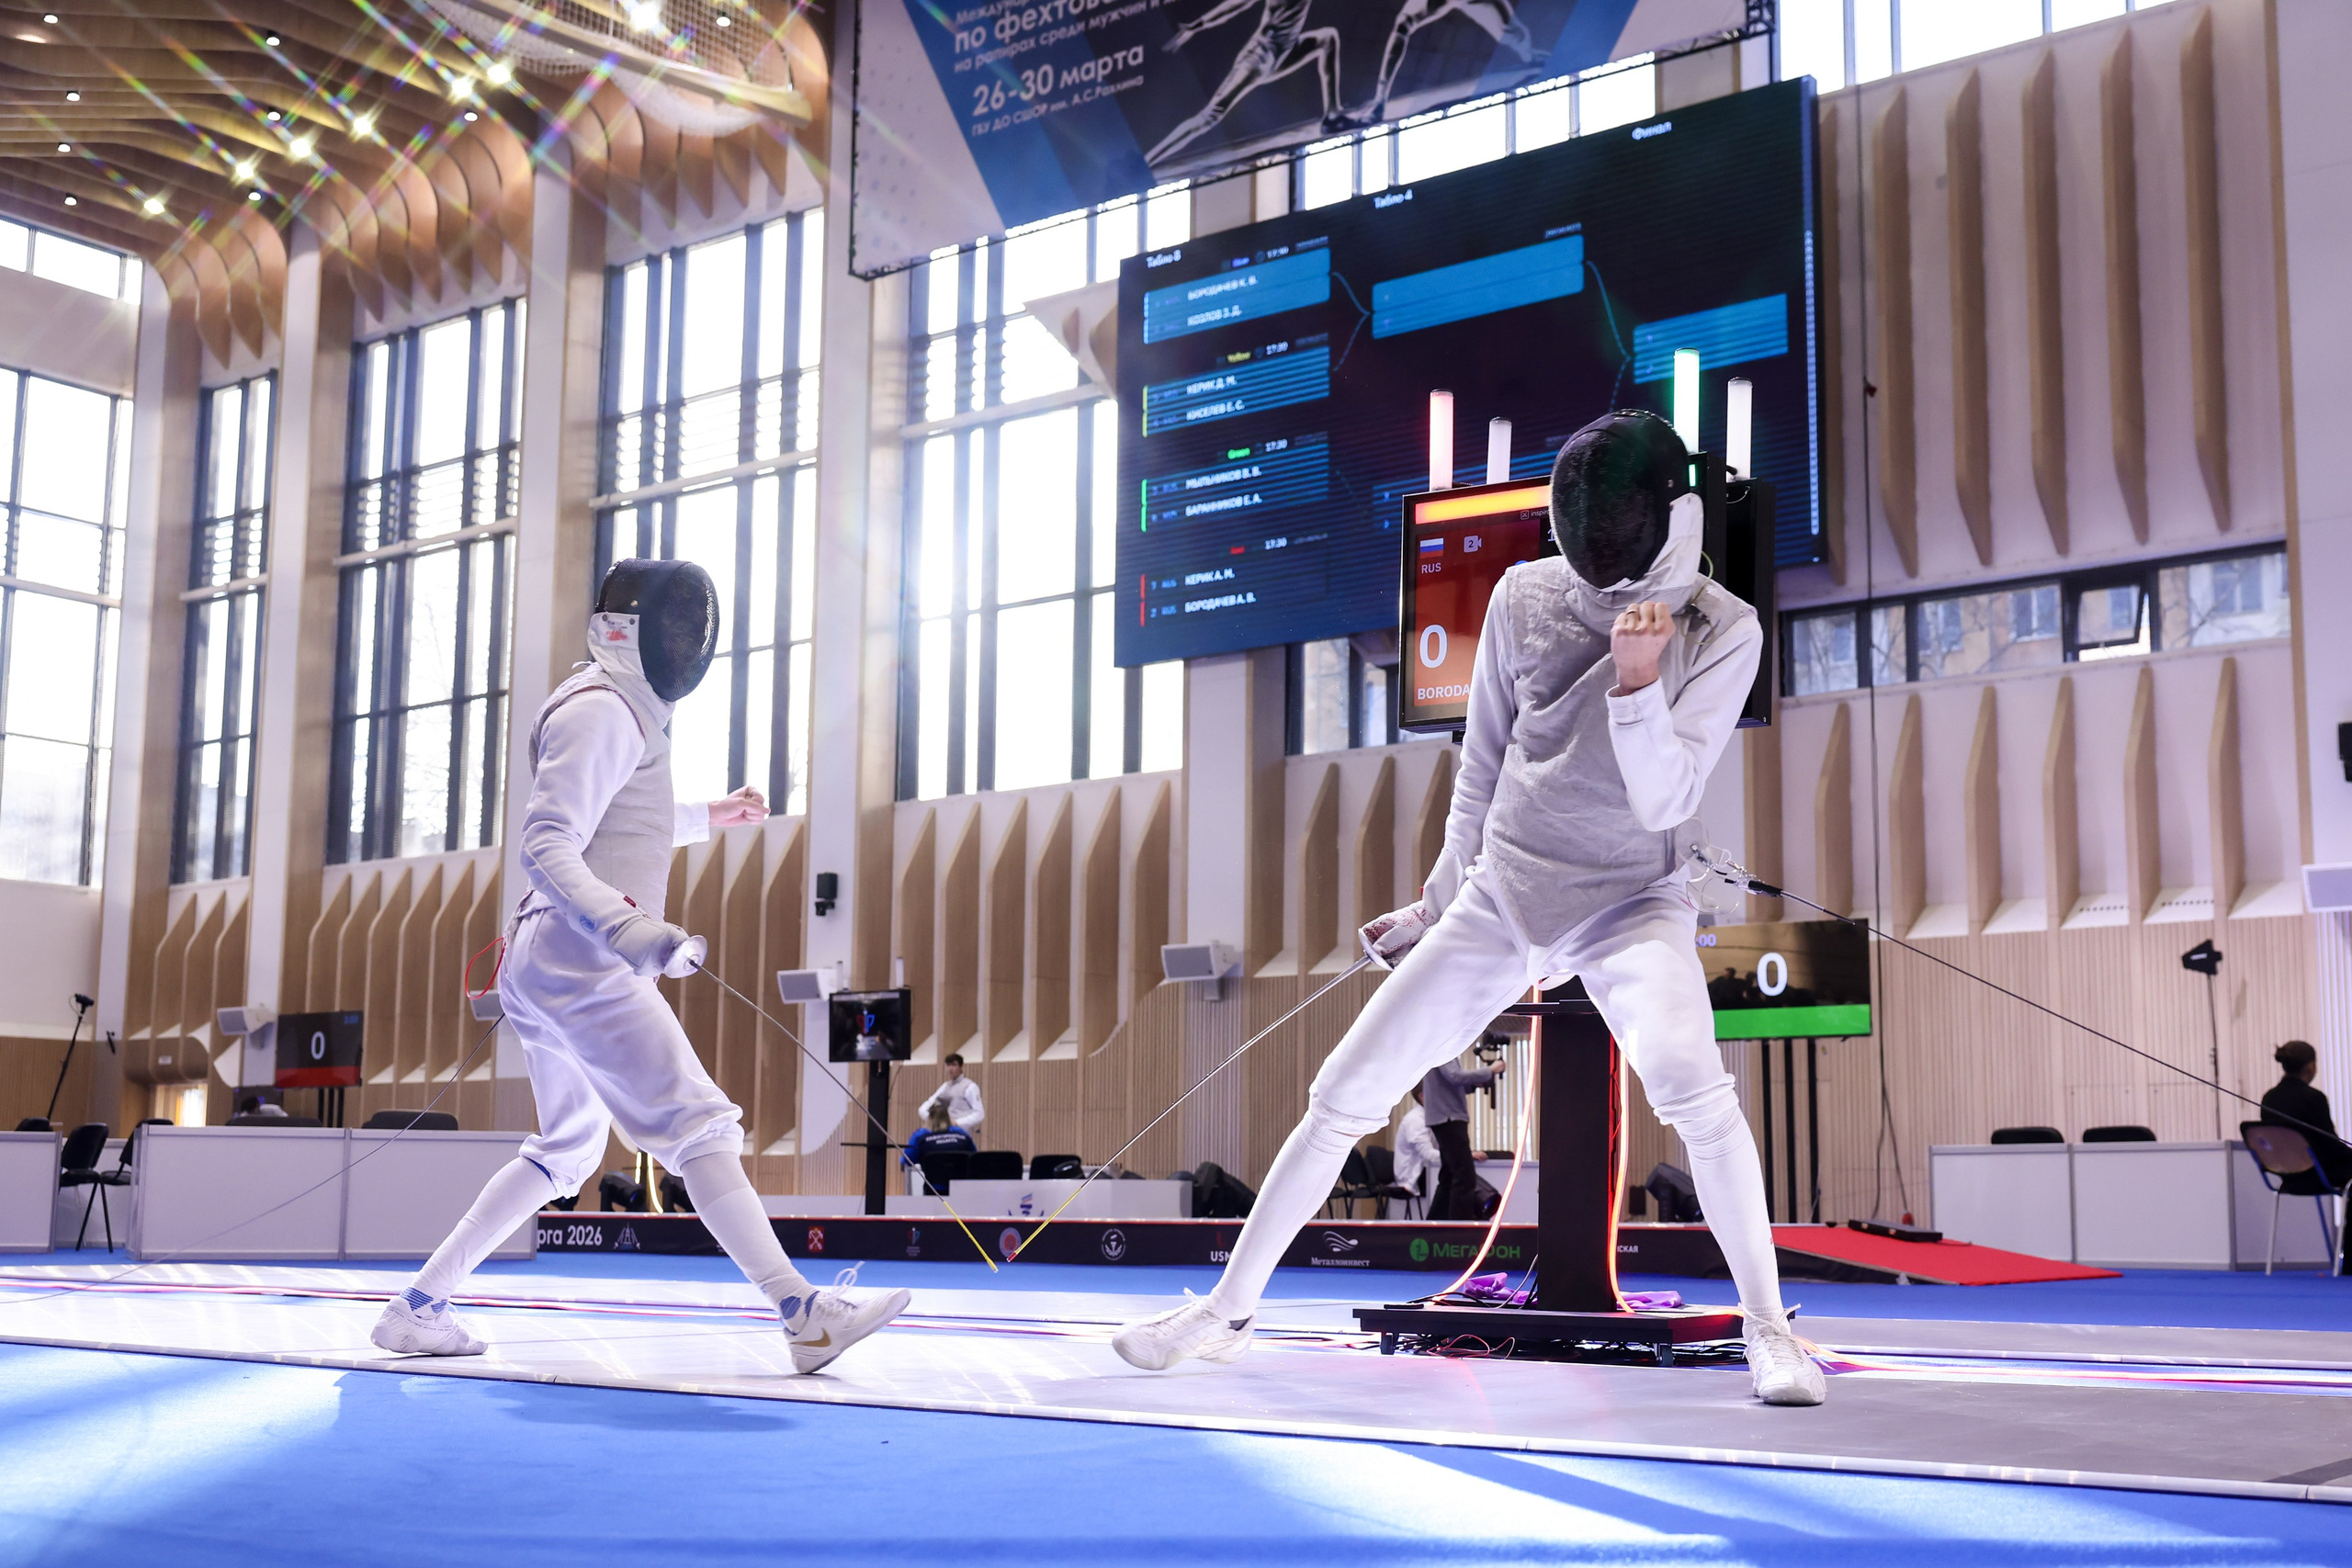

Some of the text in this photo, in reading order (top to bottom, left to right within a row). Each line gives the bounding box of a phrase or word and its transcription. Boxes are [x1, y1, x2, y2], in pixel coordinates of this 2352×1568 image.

[955, 0, 1114, 53] по фехтов
[955, 58, 972, 73] на
[975, 38, 1036, 70] рапирах
[1039, 21, 1085, 46] среди
[1089, 1, 1147, 29] мужчин
[972, 44, 1144, 117] 26-30 марта
[992, 115, 1011, 131] ДО
[1632, 121, 1672, 140] Финал
[1374, 188, 1413, 209] Табло 4
[1146, 253, 1173, 268] Табло
[1187, 309, 1223, 327] КОЗЛОВ
[1186, 378, 1216, 395] КЕРИК
[1186, 402, 1227, 421] КИСЕЛЕВ
[1468, 540, 1474, 548] 2
[1421, 562, 1442, 574] RUS
[1185, 570, 1215, 585] КЕРИК
[1185, 595, 1237, 613] БОРОДАЧЕВ
[1419, 624, 1448, 669] 0
[1418, 683, 1470, 700] BORODA
[1757, 952, 1788, 997] 0
[311, 1031, 325, 1060] 0
[566, 1224, 603, 1247] 2026
[1311, 1256, 1371, 1267] Металлоинвест
